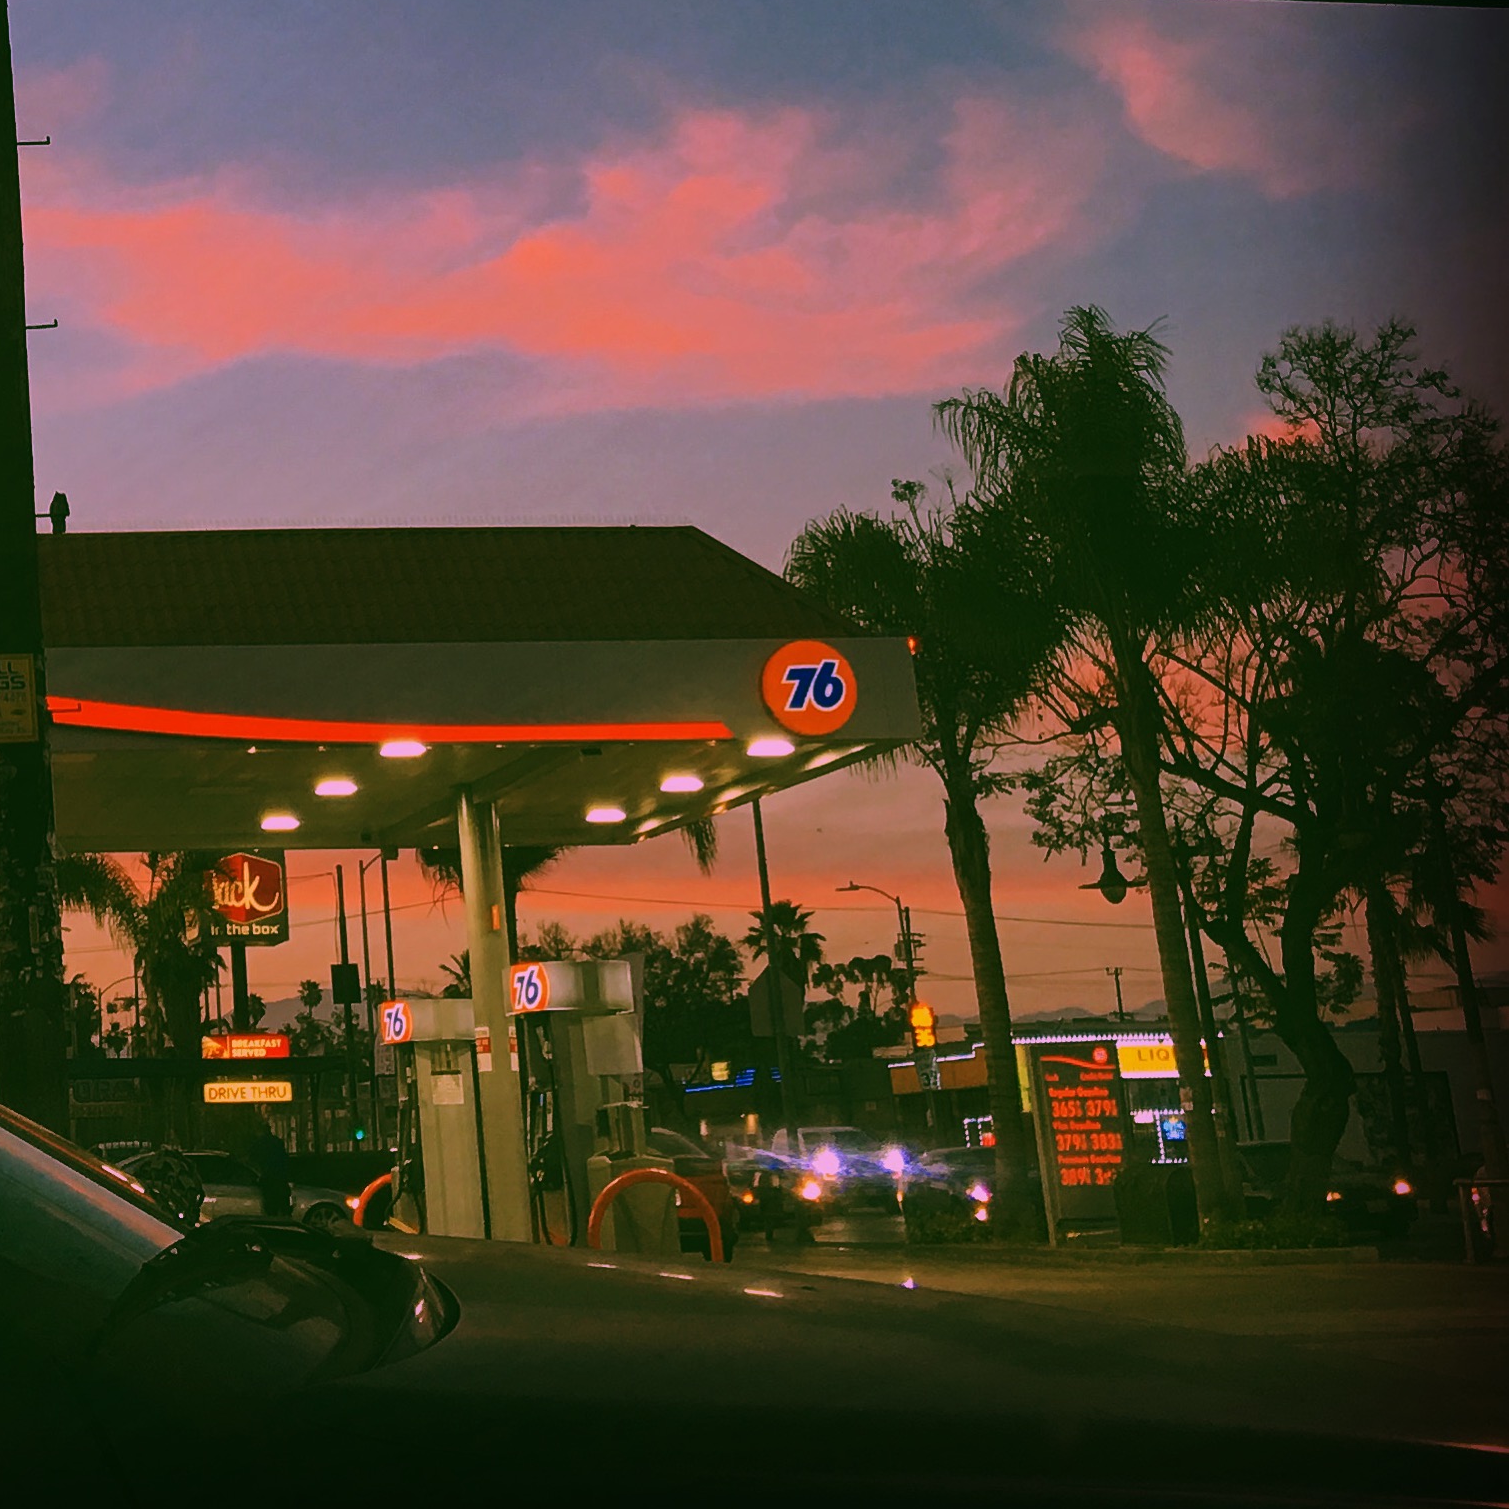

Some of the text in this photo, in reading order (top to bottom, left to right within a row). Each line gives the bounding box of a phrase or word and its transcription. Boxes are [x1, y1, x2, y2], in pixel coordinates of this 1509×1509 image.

[781, 659, 846, 712] 76
[226, 923, 250, 936] the
[252, 923, 280, 935] box
[513, 965, 543, 1010] 76
[383, 1002, 406, 1042] 76
[231, 1039, 281, 1048] BREAKFAST
[231, 1048, 267, 1058] SERVED
[1138, 1048, 1170, 1062] LIQ
[208, 1085, 287, 1100] DRIVE THRU
